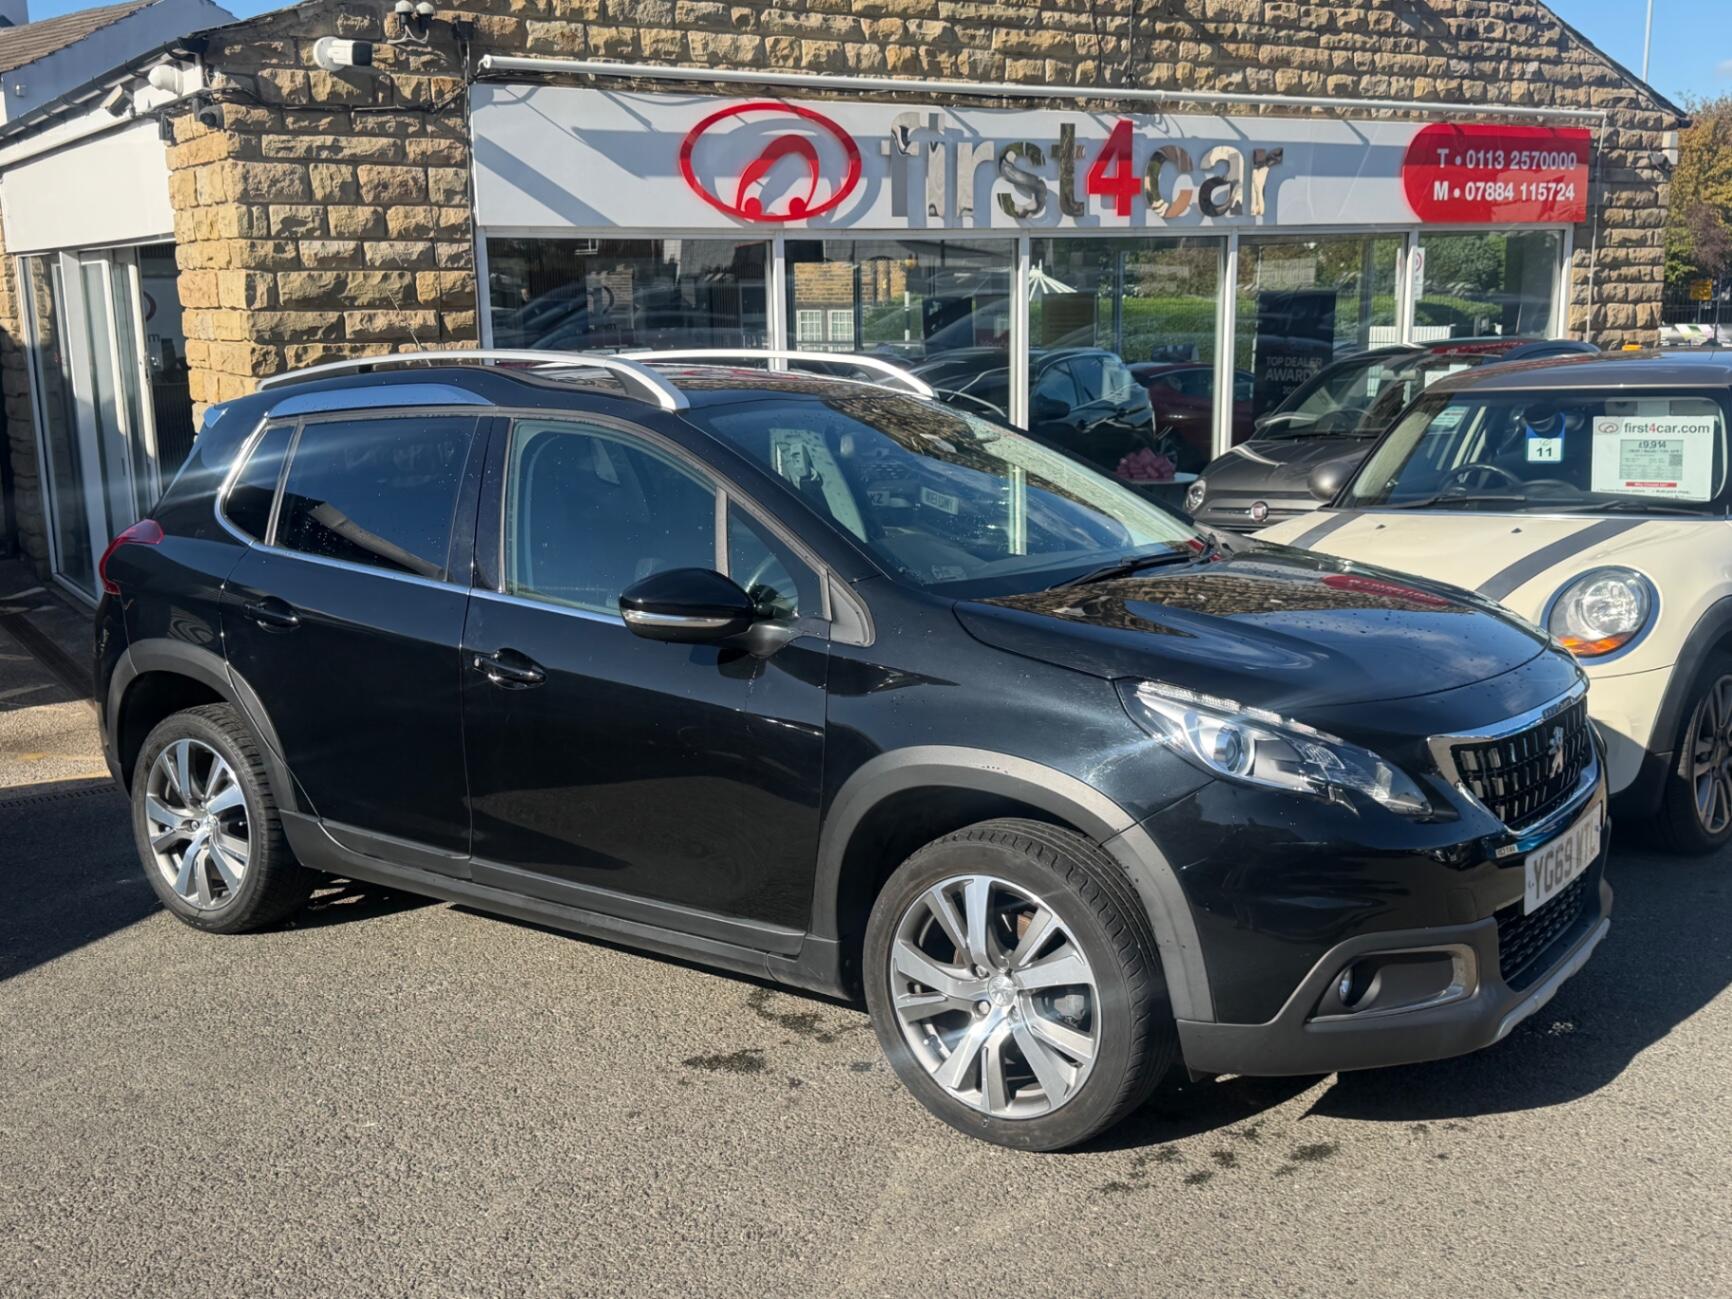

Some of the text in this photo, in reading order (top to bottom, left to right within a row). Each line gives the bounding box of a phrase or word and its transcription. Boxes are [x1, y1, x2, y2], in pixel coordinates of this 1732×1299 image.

[881, 111, 1283, 219] first4car
[1437, 148, 1577, 171] T 0113 2570000
[1433, 181, 1575, 202] M 07884 115724
[1265, 356, 1322, 368] TOP DEALER
[1264, 368, 1319, 381] AWARD
[1624, 422, 1710, 434] first4car.com
[1536, 447, 1552, 457] 11
[1533, 836, 1573, 900] YG69
